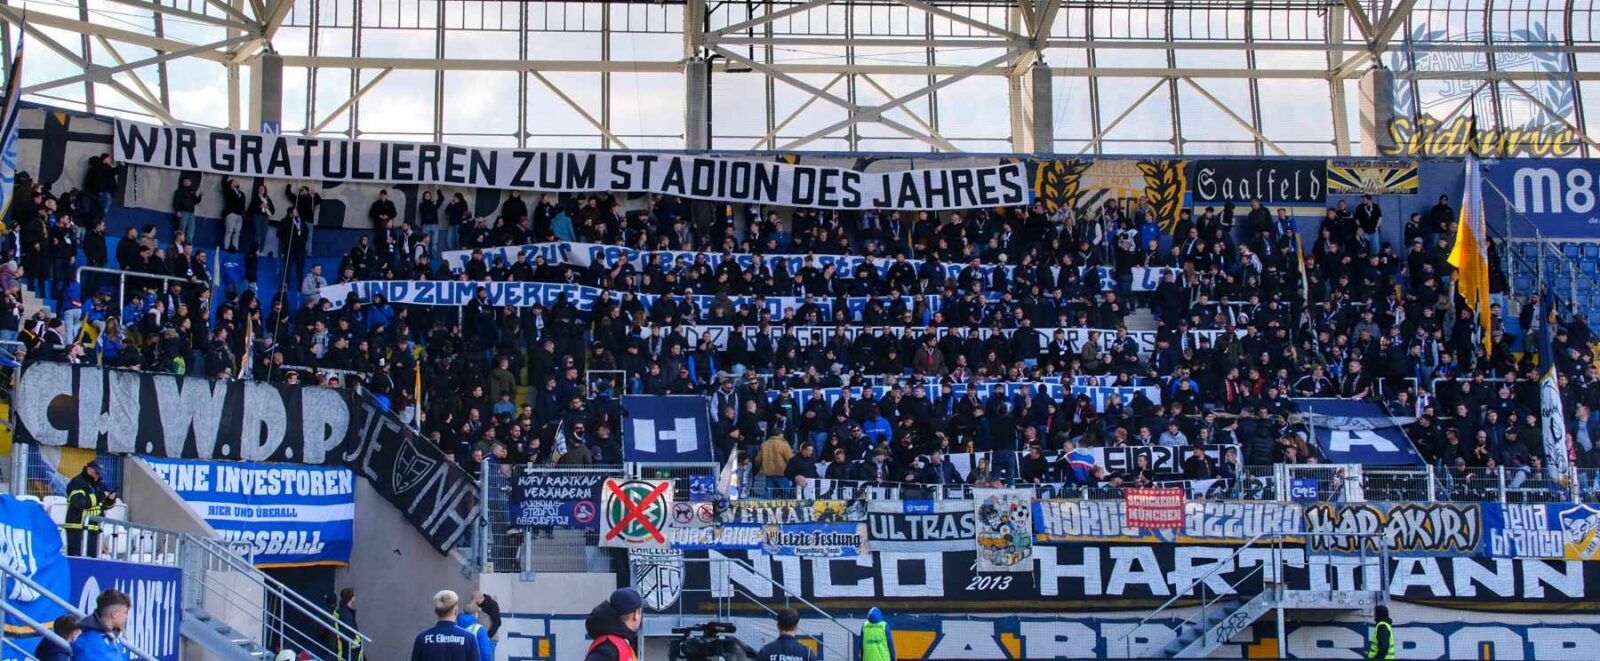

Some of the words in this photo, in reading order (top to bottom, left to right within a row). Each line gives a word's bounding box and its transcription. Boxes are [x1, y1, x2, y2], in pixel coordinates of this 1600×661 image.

[116, 119, 198, 168] WIR
[210, 132, 498, 186] GRATULIEREN
[510, 151, 595, 190] ZUM
[610, 155, 778, 201] STADION
[791, 167, 861, 208] DES
[873, 165, 1023, 209] JAHRES
[1198, 168, 1321, 200] Saalfeld
[1513, 168, 1600, 213] m8
[632, 418, 699, 454] H
[150, 463, 209, 492] EINE
[216, 465, 353, 497] INVESTOREN
[208, 505, 231, 517] HIER
[234, 505, 253, 518] UND
[256, 504, 298, 518] ÜBERALL
[1128, 507, 1181, 521] MÜNCHEN
[813, 530, 862, 548] Festung
[868, 513, 975, 540] ULTRAS
[708, 548, 944, 598] NICO
[1032, 546, 1585, 598] HARTMANN
[965, 576, 1014, 591] 2013
[424, 634, 434, 644] FC
